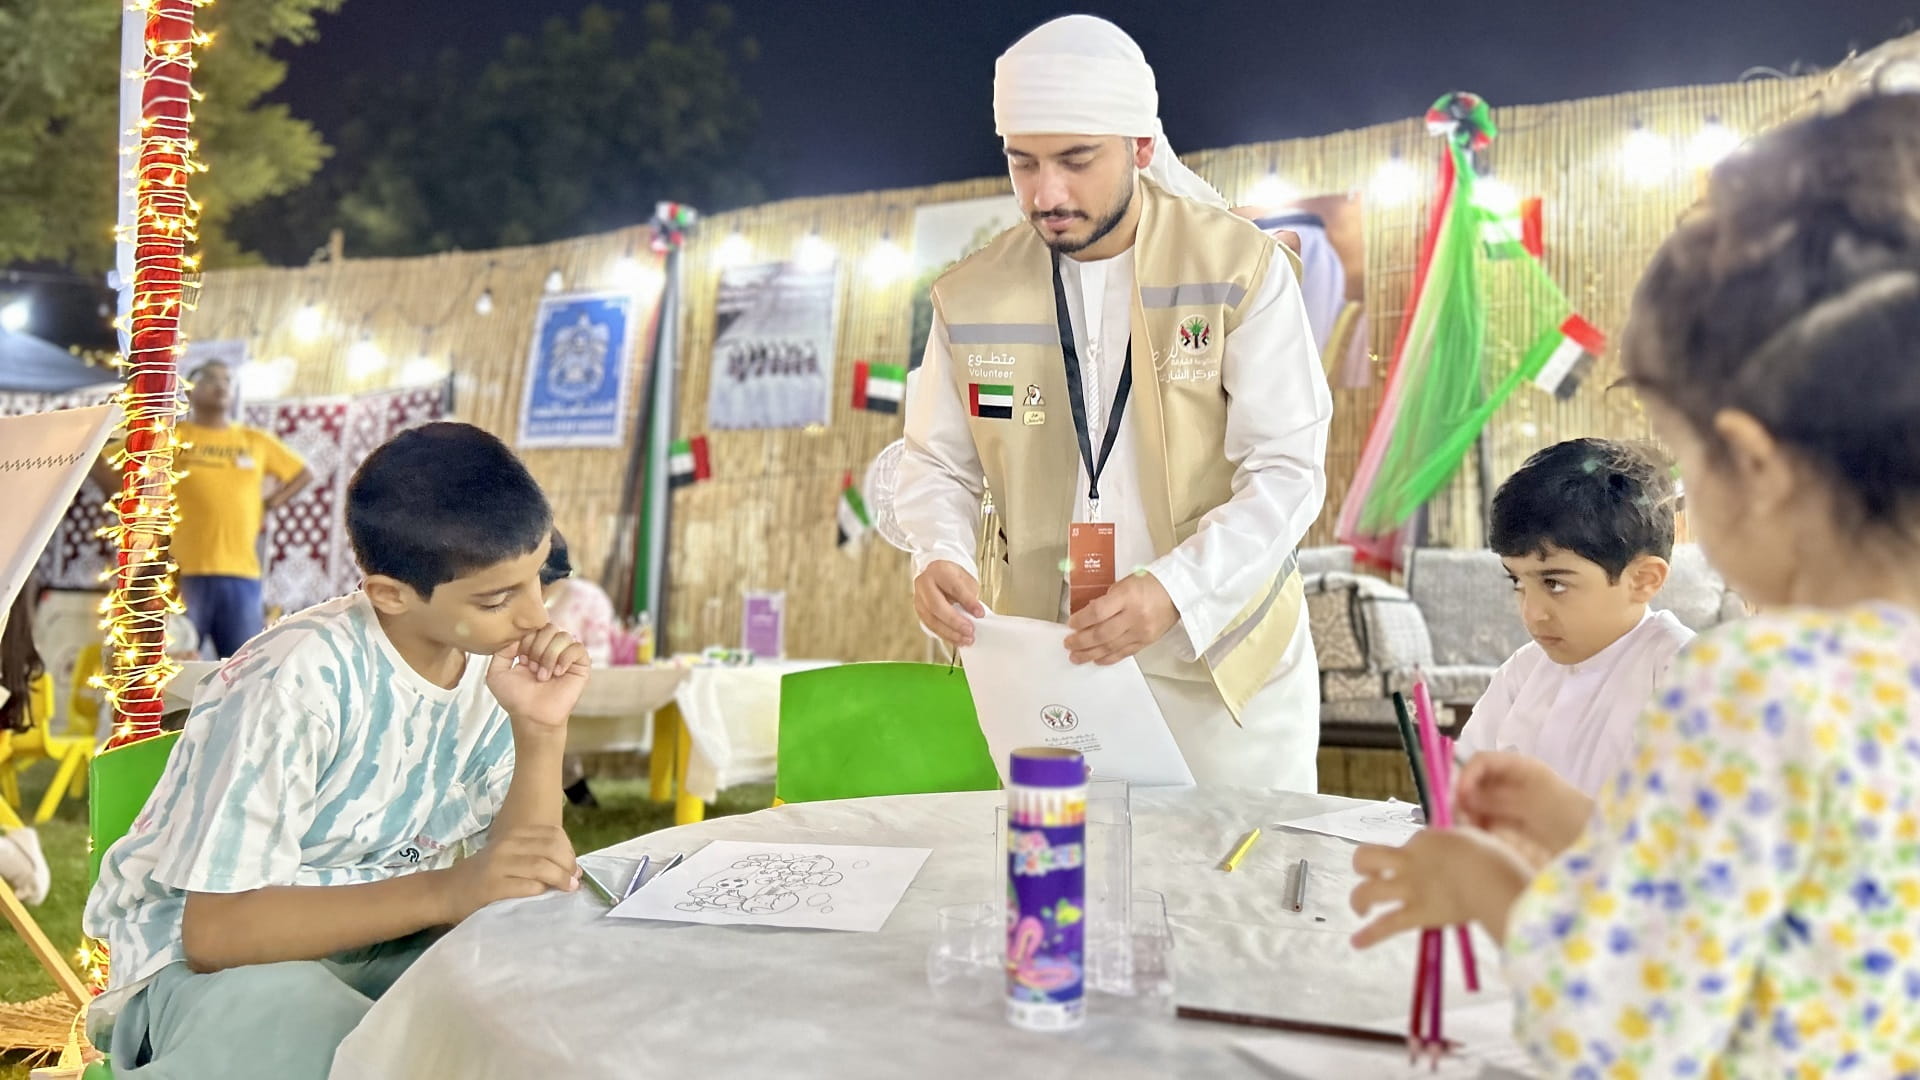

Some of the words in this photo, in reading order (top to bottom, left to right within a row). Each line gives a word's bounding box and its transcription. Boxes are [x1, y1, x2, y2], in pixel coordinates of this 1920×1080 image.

[967, 351, 1016, 368] متطوع
[968, 368, 1014, 379] Volunteer
[1190, 368, 1218, 383] مركز
